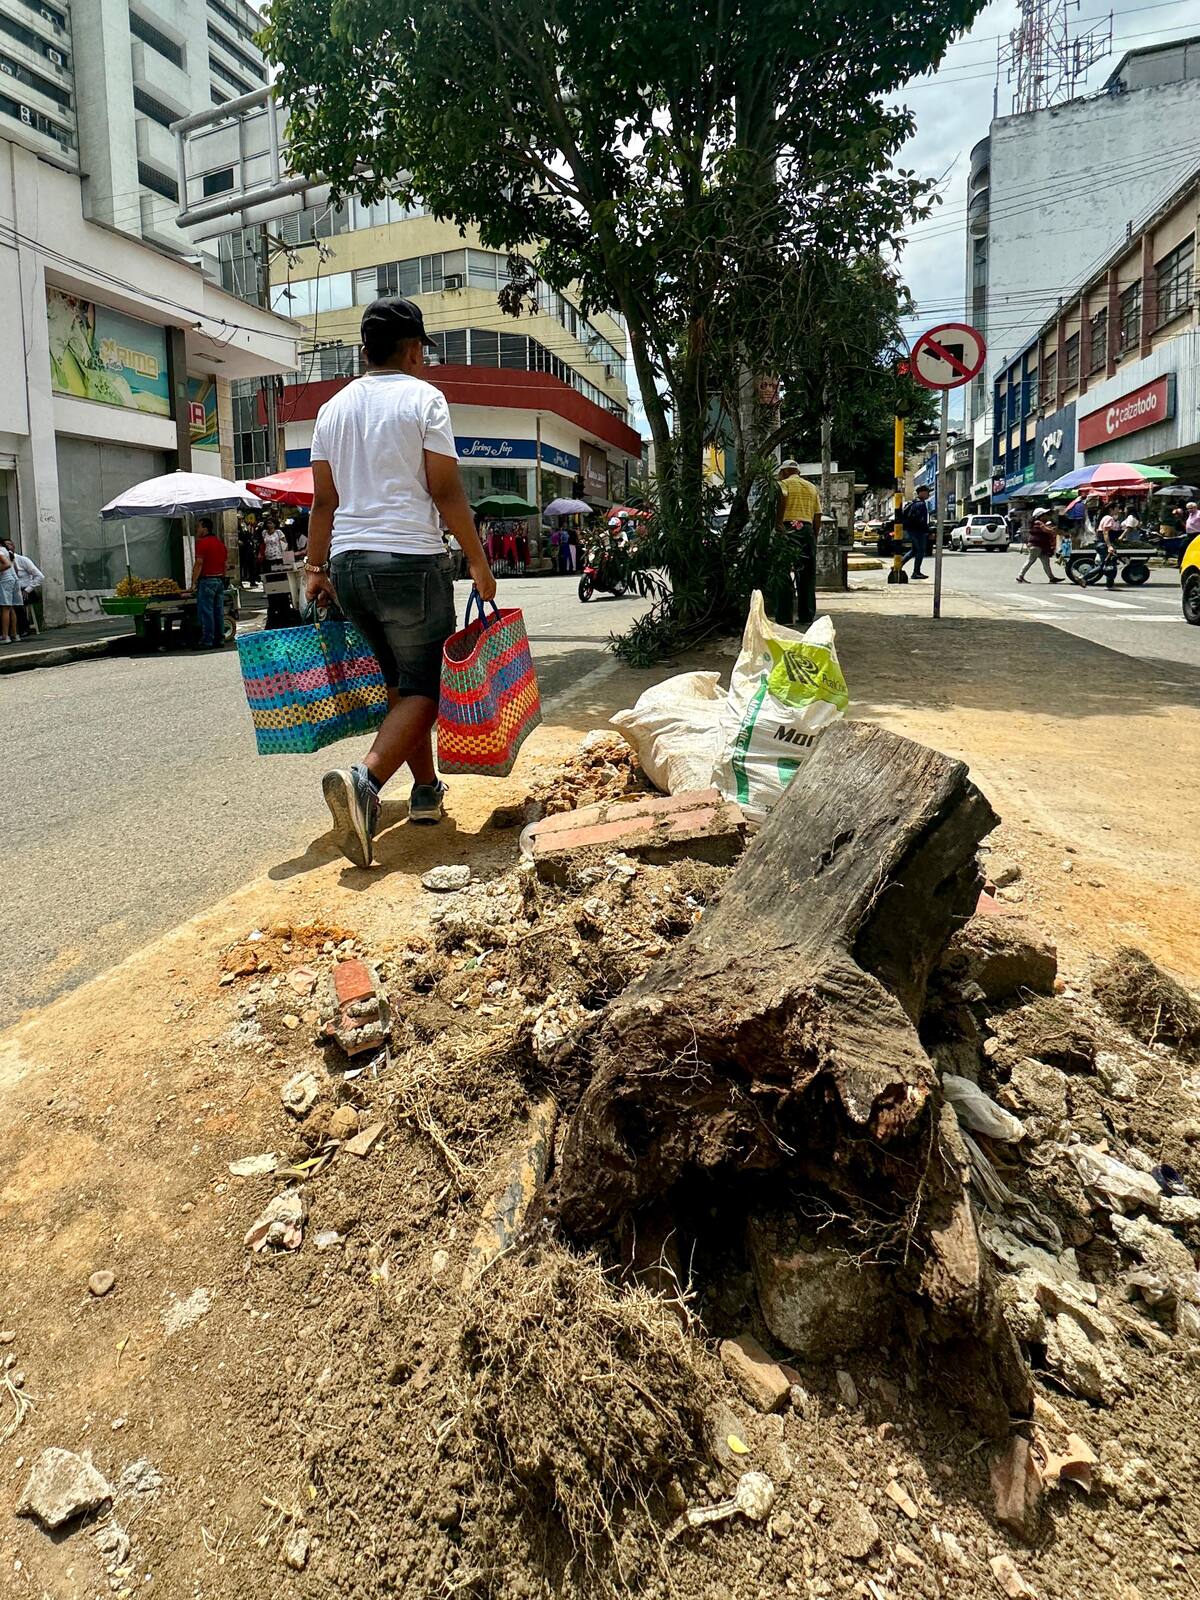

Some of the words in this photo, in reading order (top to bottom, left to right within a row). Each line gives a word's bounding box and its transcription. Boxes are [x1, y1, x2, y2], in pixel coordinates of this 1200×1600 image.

[1120, 392, 1158, 423] calzatodo
[462, 440, 492, 455] Spring
[491, 441, 513, 457] Step
